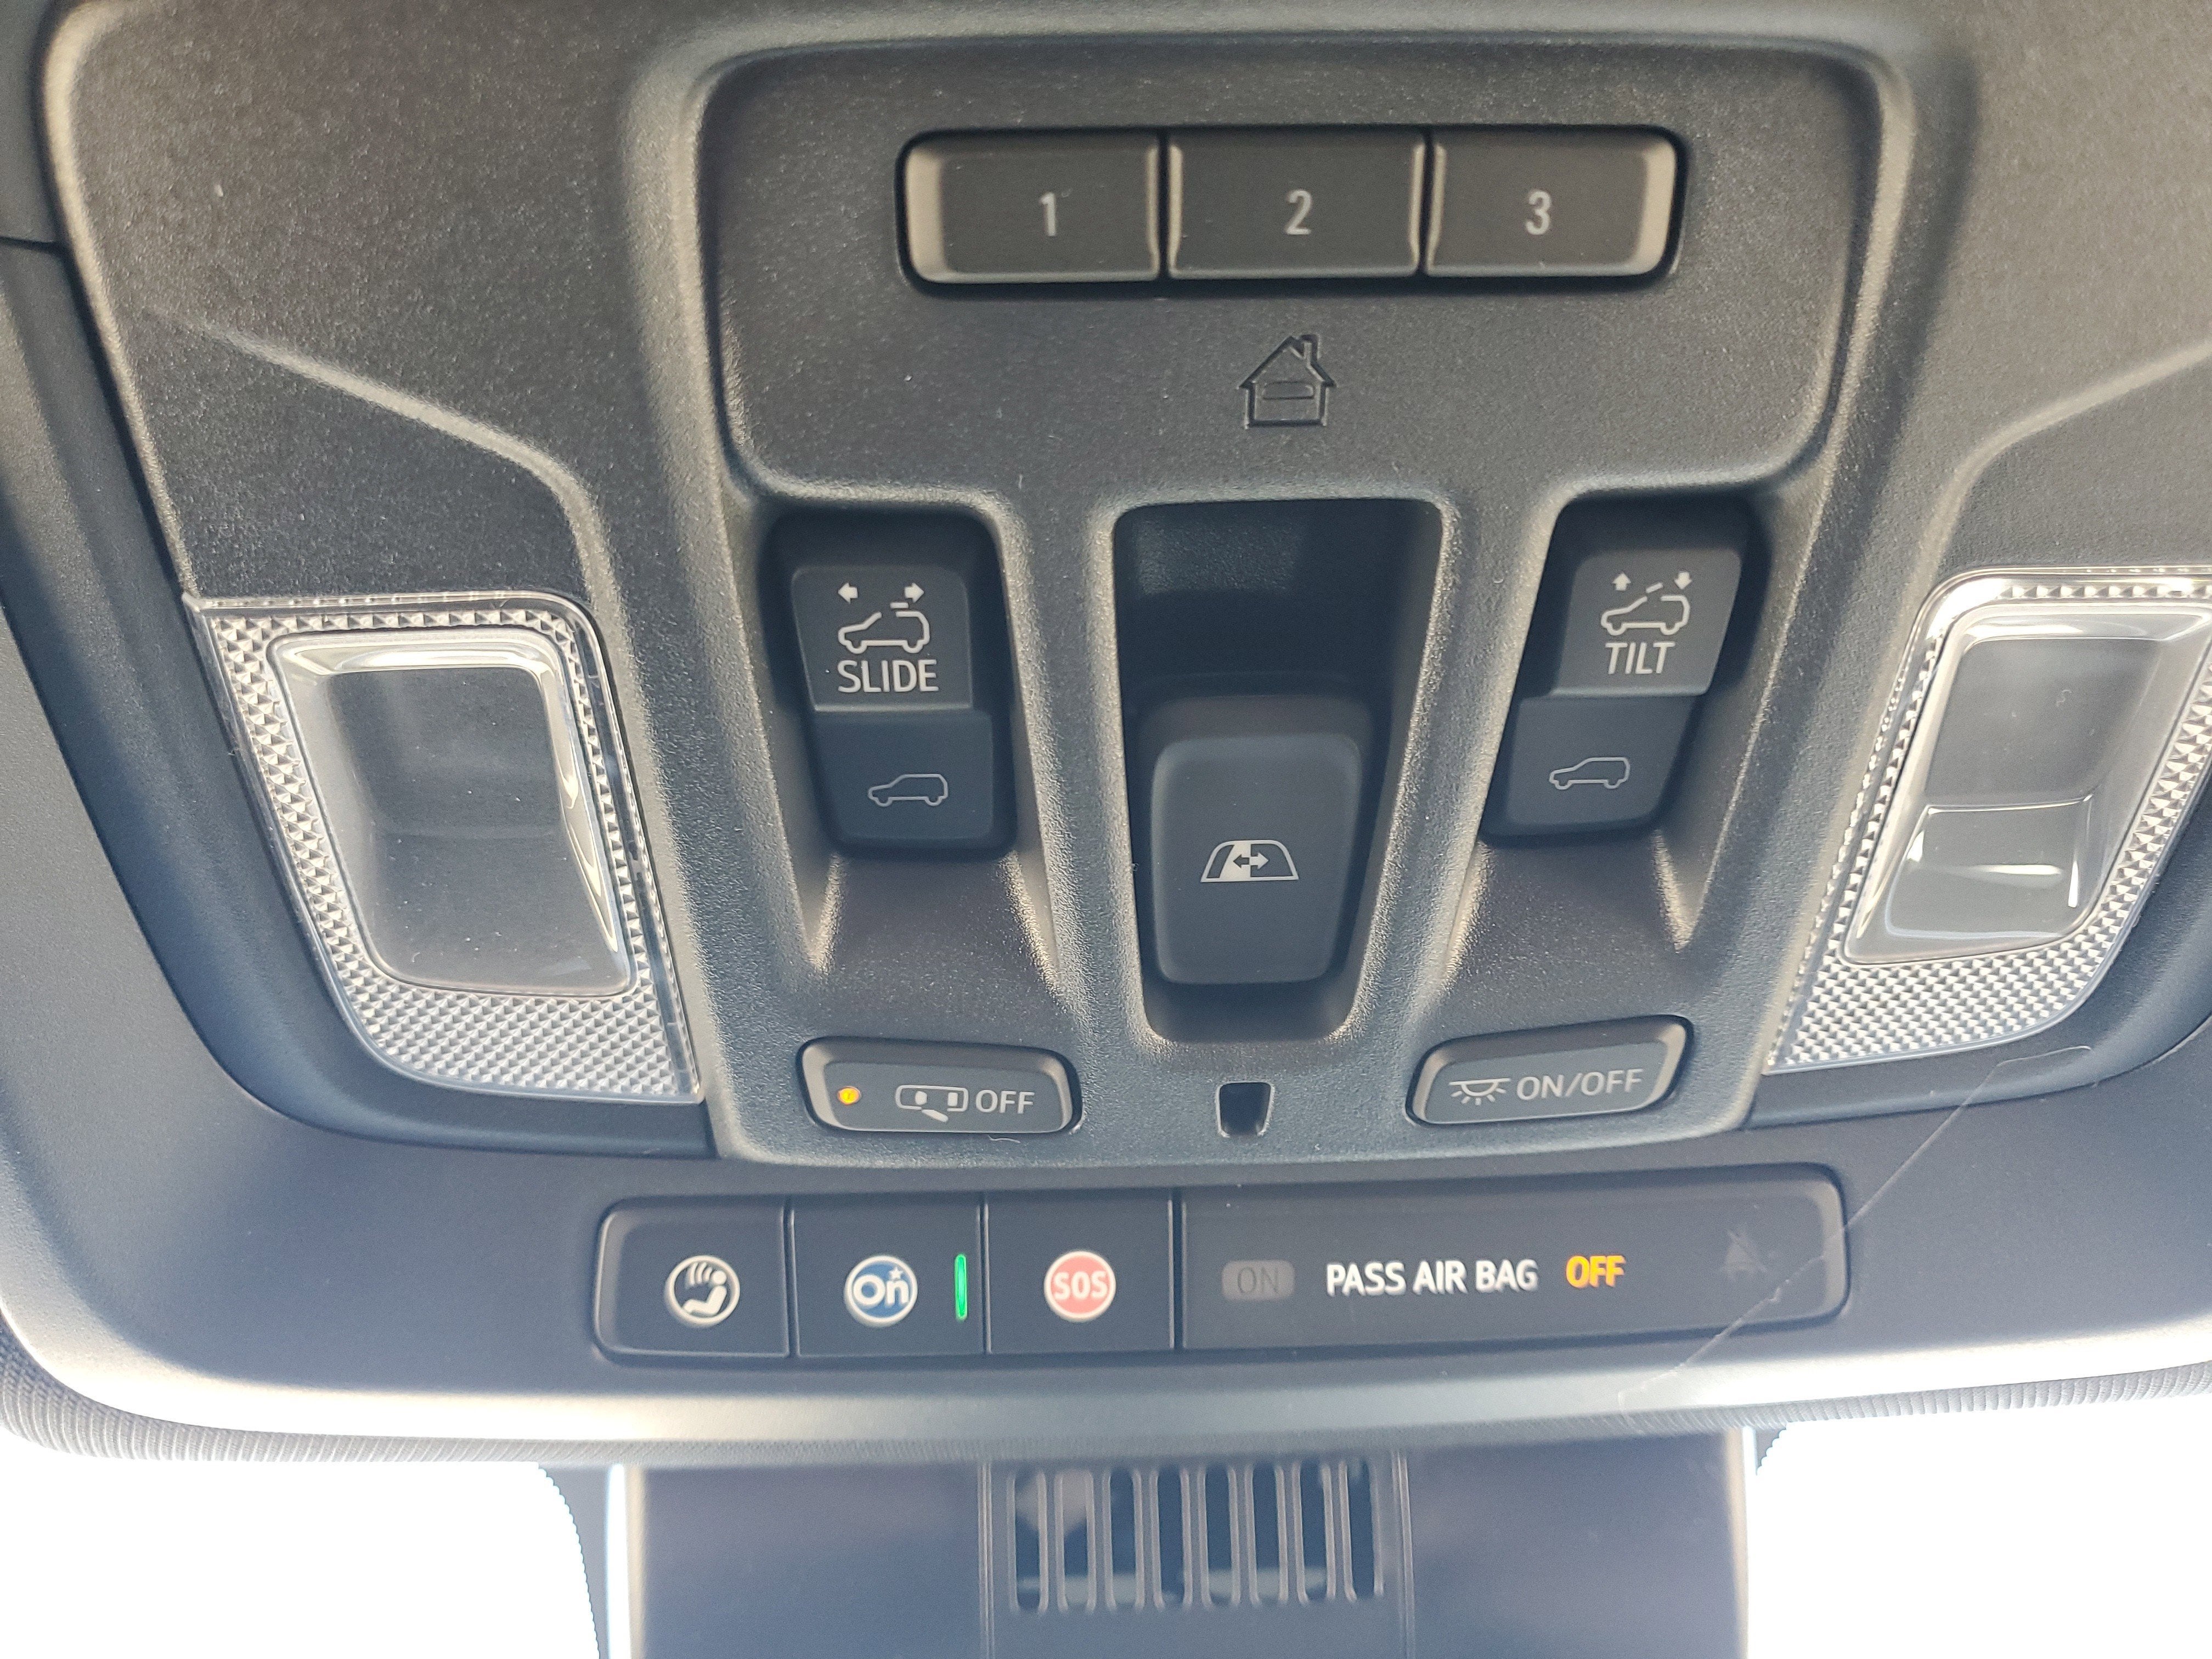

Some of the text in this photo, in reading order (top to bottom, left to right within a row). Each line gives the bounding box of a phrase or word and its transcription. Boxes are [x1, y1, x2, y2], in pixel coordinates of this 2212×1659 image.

[1040, 191, 1057, 236] 1
[1285, 190, 1312, 235] 2
[1524, 190, 1552, 236] 3
[1605, 641, 1676, 675] TILT
[837, 659, 939, 693] SLIDE
[975, 1089, 1035, 1114] OFF
[1516, 1068, 1644, 1101] ON/OFF
[1053, 1270, 1109, 1301] SOS
[1235, 1265, 1281, 1294] ON
[1325, 1259, 1538, 1296] PASS AIR BAG
[1565, 1255, 1626, 1289] OFF
